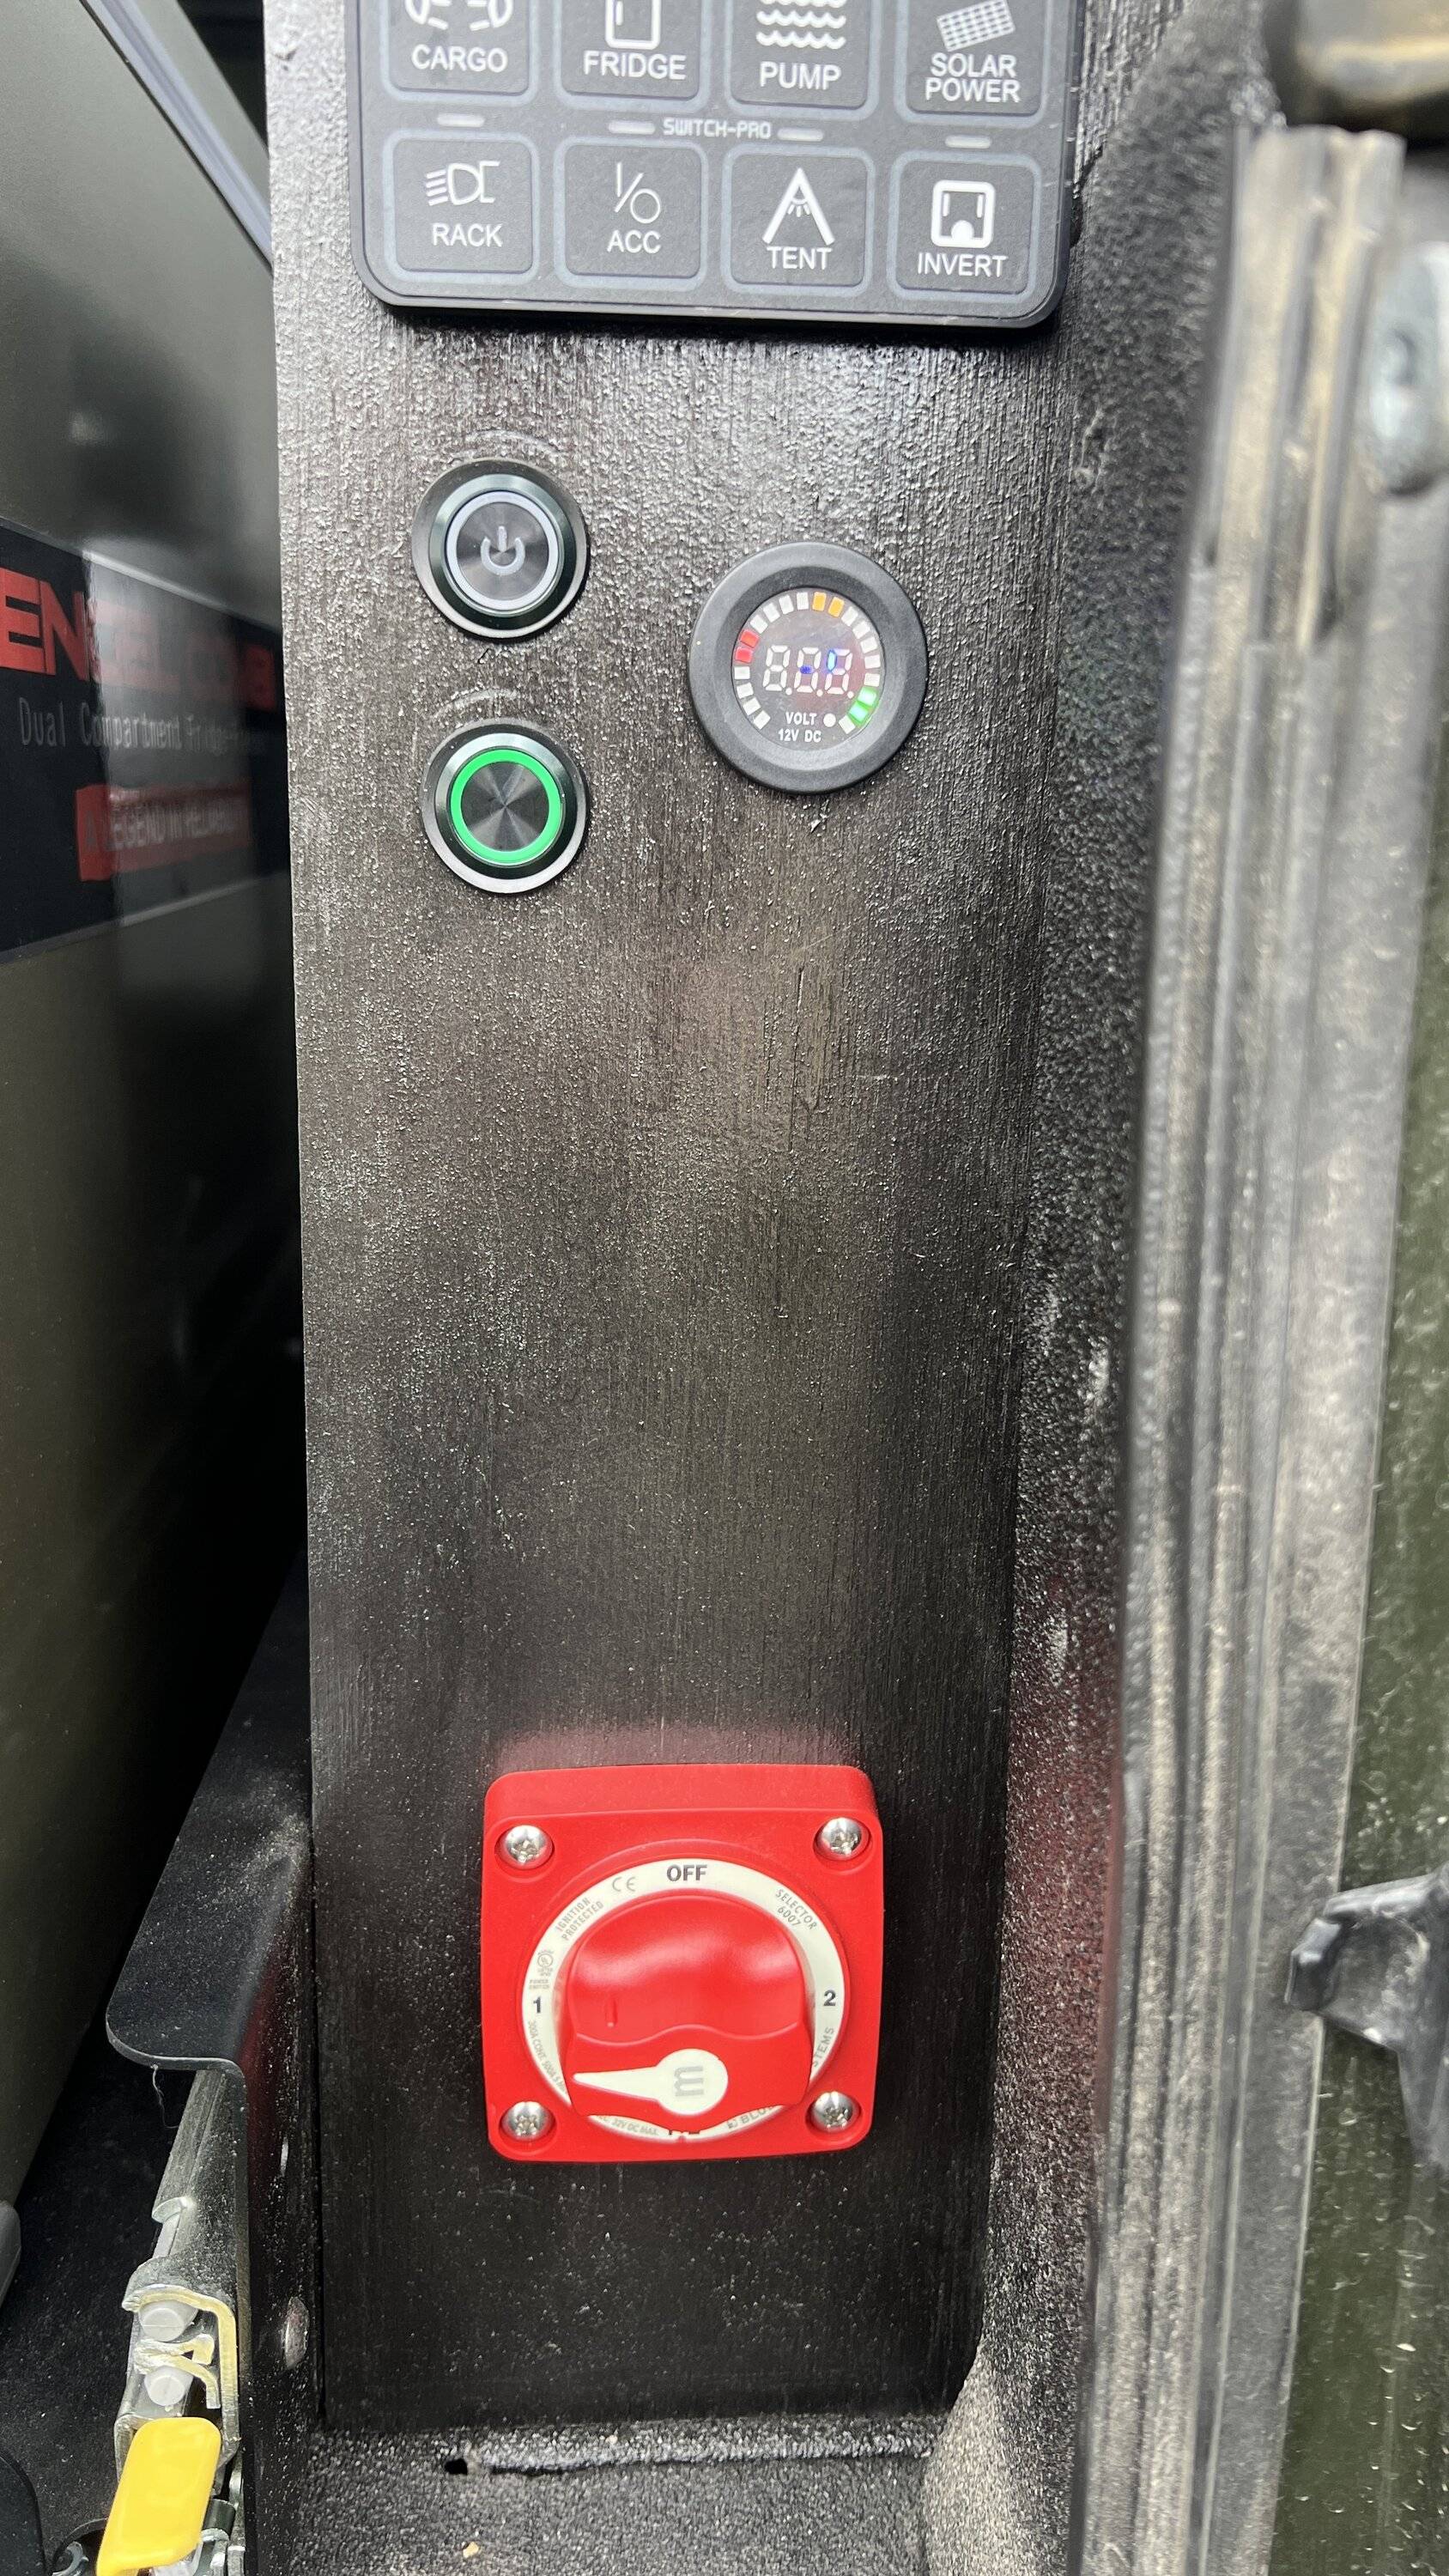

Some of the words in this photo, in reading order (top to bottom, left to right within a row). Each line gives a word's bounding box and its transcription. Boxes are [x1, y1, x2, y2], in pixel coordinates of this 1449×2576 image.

[411, 44, 508, 73] CARGO
[583, 50, 687, 81] FRIDGE
[930, 52, 1017, 79] SOLAR
[760, 62, 840, 91] PUMP
[925, 77, 1020, 103] POWER
[662, 118, 772, 140] SWITCH-PRO
[432, 222, 504, 248] RACK
[607, 229, 661, 255] ACC
[767, 246, 833, 271] TENT
[917, 253, 1008, 278] INVERT
[19, 696, 66, 747] Dual
[82, 702, 182, 750] Compartment
[785, 712, 817, 726] VOLT
[778, 729, 798, 742] 12V
[804, 730, 822, 743] DC
[666, 1864, 707, 1881] OFF
[555, 1897, 591, 1932] IGNITION
[561, 1900, 603, 1941] PROTECTED
[775, 1889, 817, 1929] SELECTOR
[533, 1996, 541, 2013] 1
[823, 1990, 836, 2007] 2
[741, 2106, 773, 2124] BLU
